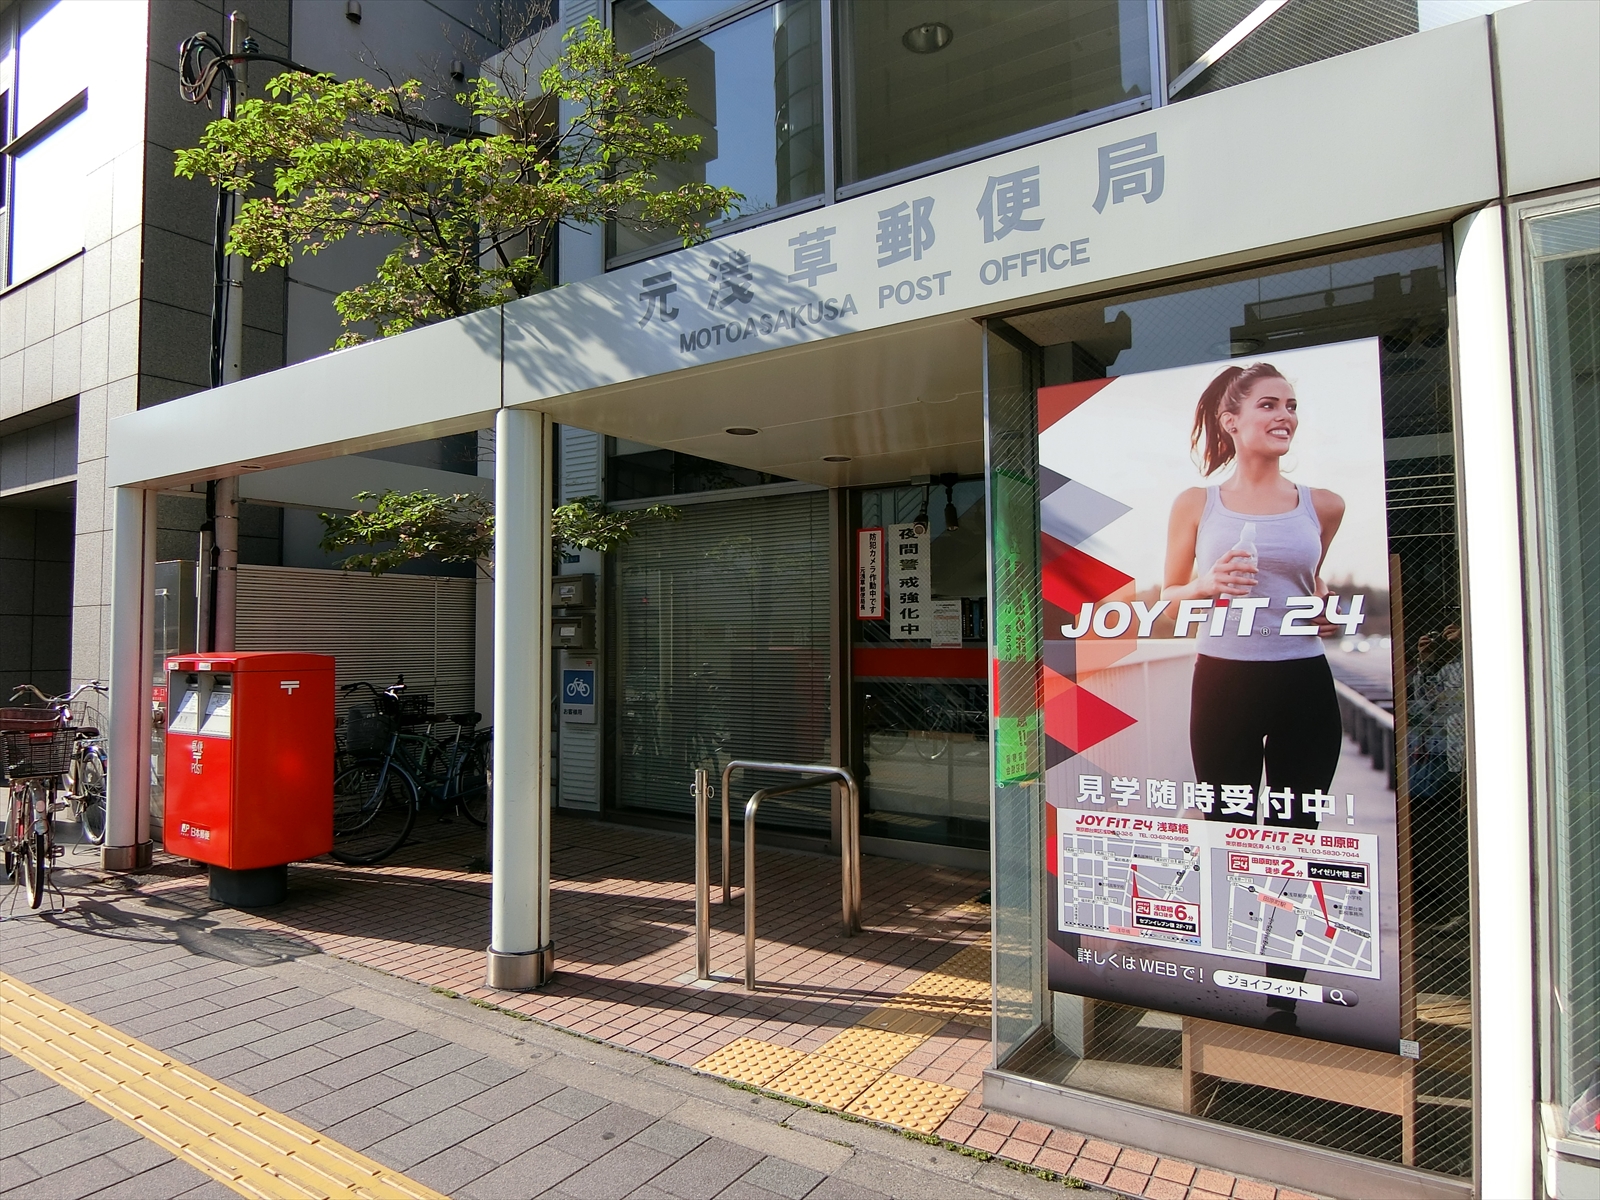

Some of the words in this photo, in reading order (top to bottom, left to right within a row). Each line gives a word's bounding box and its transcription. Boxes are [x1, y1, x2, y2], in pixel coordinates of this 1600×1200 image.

[637, 132, 1165, 330] 元浅草郵便局
[680, 297, 858, 353] MOTOASAKUSA
[878, 270, 952, 309] POST
[979, 237, 1090, 286] OFFICE
[869, 533, 877, 614] 防犯カメラ作動中です
[899, 528, 919, 635] 夜間警戒強化中
[1061, 601, 1165, 639] JOY
[1279, 594, 1365, 636] 24
[563, 708, 583, 716] お客様用
[191, 763, 203, 774] POST
[1076, 814, 1105, 826] JOY
[1132, 819, 1153, 831] 24
[1157, 821, 1189, 835] 浅草橋
[1225, 827, 1259, 840] JOY
[1292, 832, 1315, 845] 24
[1320, 835, 1360, 850] 田原町
[1232, 860, 1248, 870] 24
[1251, 857, 1280, 866] 田原町駅
[1265, 866, 1280, 874] 徒歩
[1310, 867, 1350, 878] サイゼリヤ様
[1351, 871, 1363, 879] 2F
[1136, 905, 1150, 914] 24
[1227, 973, 1309, 997] ジョイフィット
